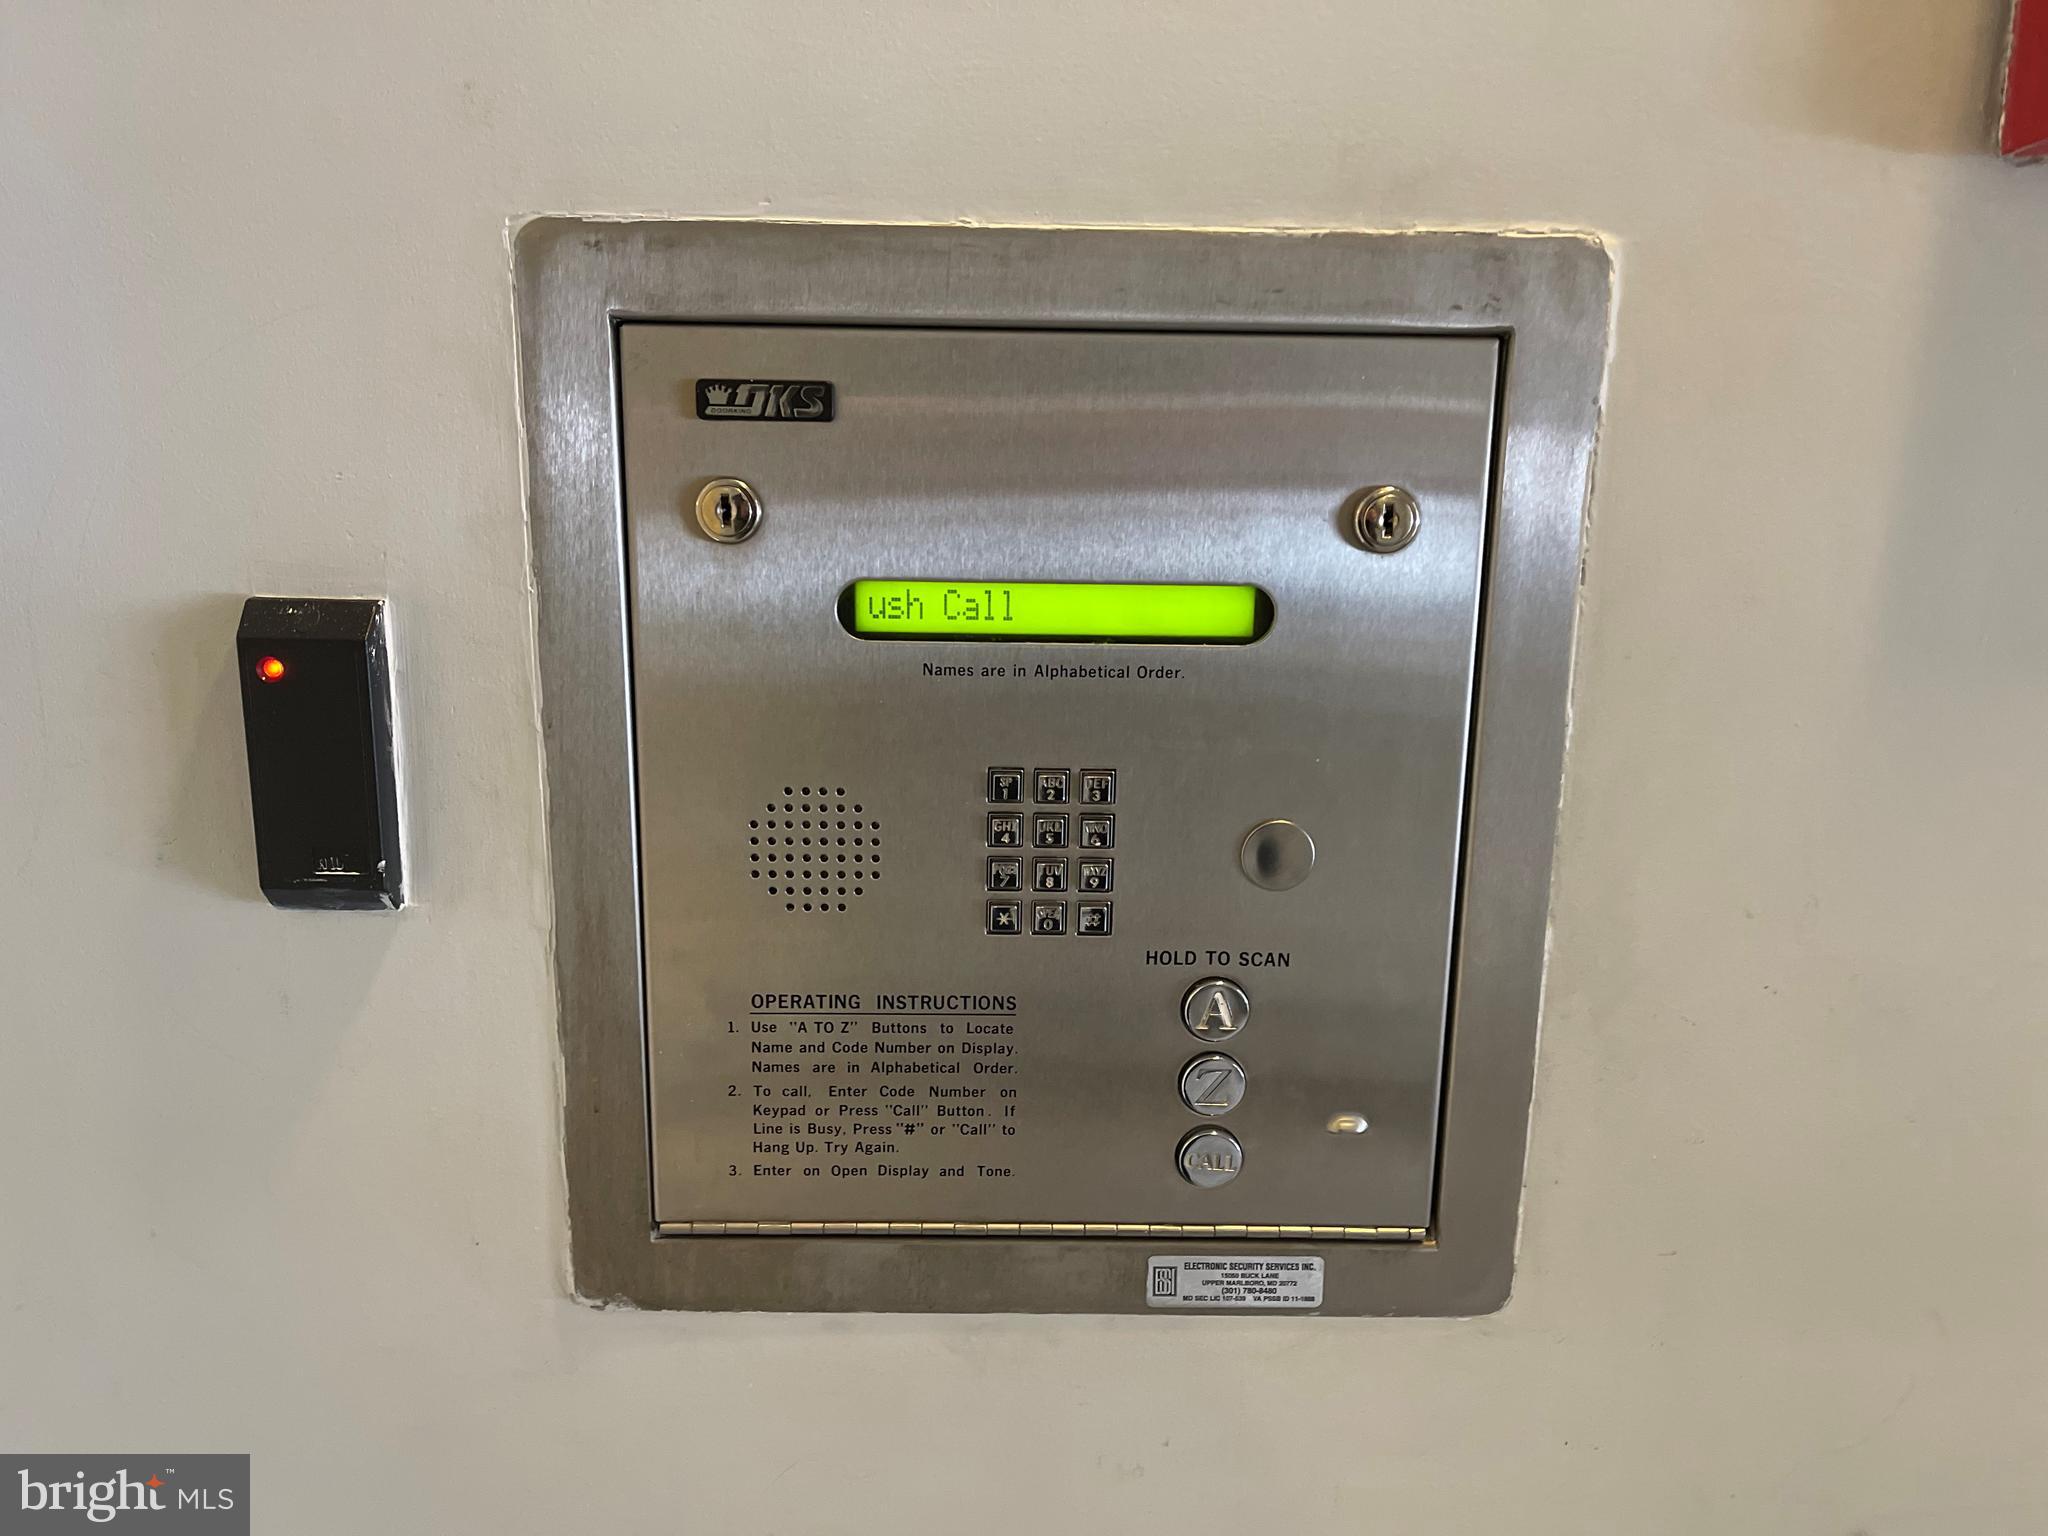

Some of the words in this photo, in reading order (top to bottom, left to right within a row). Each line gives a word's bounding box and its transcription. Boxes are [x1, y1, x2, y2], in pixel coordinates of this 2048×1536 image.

[869, 588, 924, 620] ush
[944, 589, 1014, 621] Call
[922, 662, 974, 678] Names
[980, 666, 1006, 678] are
[1013, 663, 1027, 678] in
[1033, 663, 1131, 681] Alphabetical
[1136, 665, 1186, 680] Order.
[1002, 788, 1009, 800] 1
[1046, 789, 1056, 801] 2
[1092, 791, 1101, 802] 3
[1001, 833, 1011, 844] 4
[1045, 833, 1055, 845] 5
[1090, 834, 1101, 847] 6
[1000, 874, 1010, 888] 7
[1045, 876, 1054, 888] 8
[1089, 877, 1099, 889] 9
[1145, 950, 1197, 967] HOLD
[1204, 950, 1231, 967] TO
[1238, 951, 1291, 968] SCAN
[750, 993, 861, 1010] OPERATING
[876, 994, 1017, 1011] INSTRUCTIONS
[1194, 990, 1238, 1030] A
[727, 1020, 740, 1034] 1.
[751, 1020, 778, 1034] Use
[813, 1021, 835, 1034] TO
[871, 1021, 927, 1035] Buttons
[940, 1023, 954, 1035] to
[966, 1021, 1014, 1035] Locate
[751, 1040, 793, 1054] Name
[798, 1041, 825, 1054] and
[831, 1041, 869, 1054] Code
[874, 1041, 932, 1055] Number
[937, 1044, 955, 1055] on
[961, 1041, 1019, 1058] Display.
[751, 1060, 801, 1074] Names
[812, 1063, 836, 1074] are
[847, 1061, 860, 1074] in
[870, 1060, 960, 1077] Alphabetical
[973, 1061, 1019, 1075] Order.
[727, 1084, 742, 1098] 2.
[752, 1084, 772, 1098] To
[828, 1085, 868, 1098] Enter
[879, 1085, 916, 1098] Code
[929, 1085, 987, 1099] Number
[1000, 1088, 1017, 1099] on
[1194, 1069, 1232, 1106] Z
[753, 1103, 807, 1119] Keypad
[814, 1107, 831, 1117] or
[839, 1104, 879, 1117] Press
[1004, 1105, 1016, 1118] If
[753, 1122, 783, 1135] Line
[789, 1122, 801, 1135] is
[853, 1122, 893, 1136] Press
[930, 1125, 946, 1136] or
[1001, 1124, 1016, 1137] to
[752, 1141, 790, 1157] Hang
[795, 1141, 819, 1157] Up.
[823, 1141, 849, 1157] Try
[854, 1141, 901, 1157] Again.
[1184, 1151, 1238, 1173] CALL
[728, 1164, 742, 1178] 3.
[753, 1163, 793, 1177] Enter
[803, 1167, 820, 1177] on
[830, 1164, 868, 1180] Open
[877, 1164, 930, 1181] Display
[939, 1165, 965, 1178] and
[976, 1165, 1016, 1178] Tone.
[1183, 1262, 1228, 1271] ELECTRONIC
[1229, 1262, 1263, 1271] SECURITY
[1265, 1262, 1300, 1271] SERVICES
[1301, 1262, 1317, 1272] INC.
[1221, 1286, 1241, 1296] (301)
